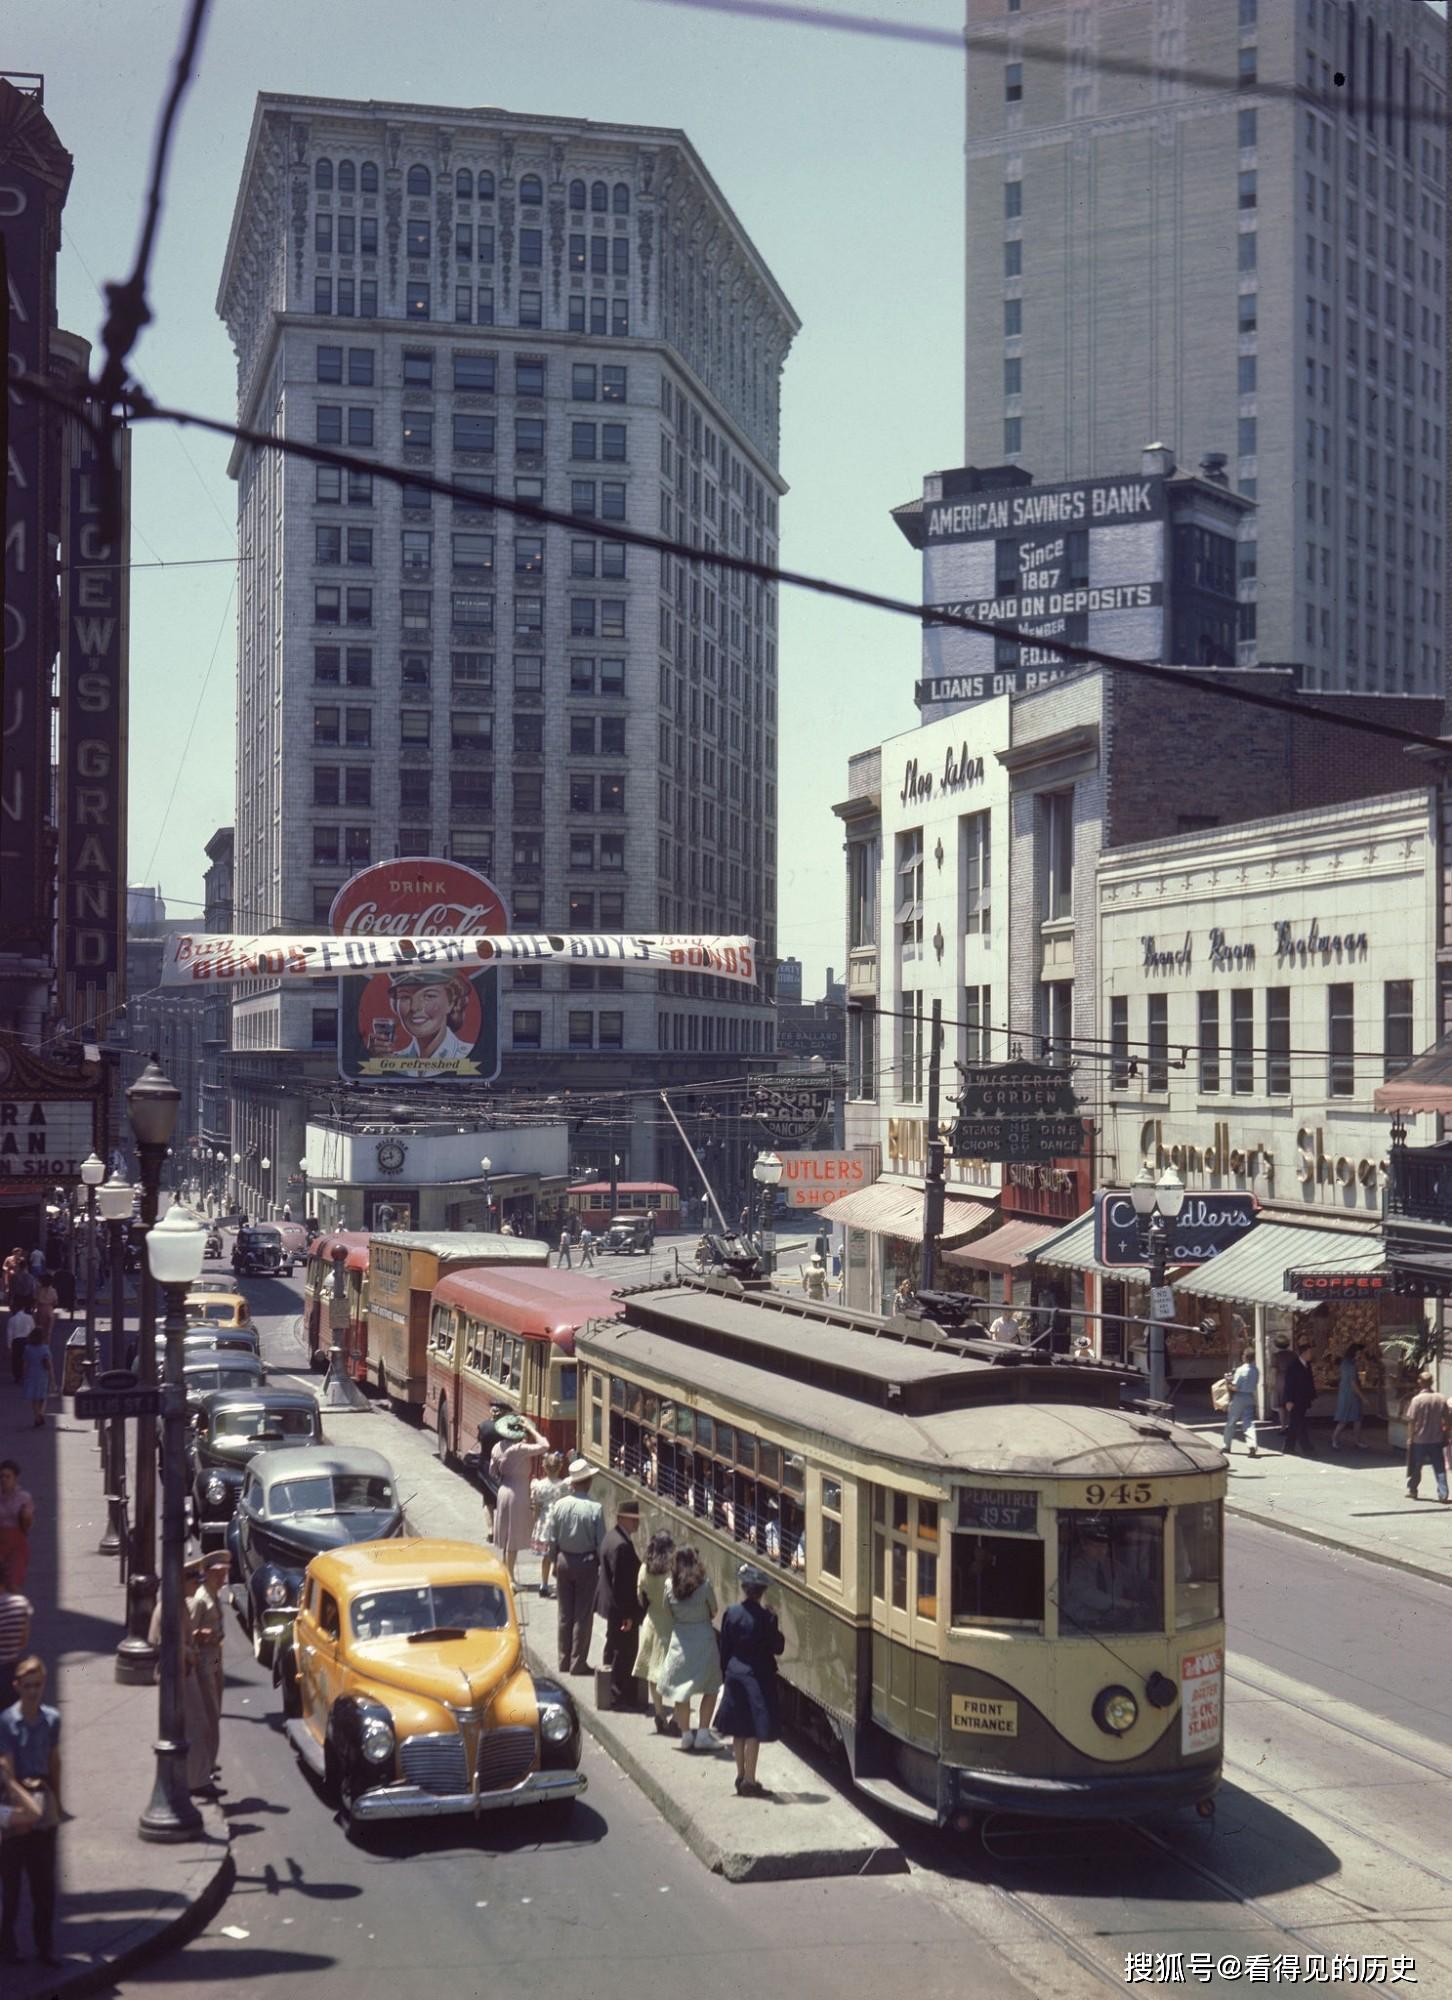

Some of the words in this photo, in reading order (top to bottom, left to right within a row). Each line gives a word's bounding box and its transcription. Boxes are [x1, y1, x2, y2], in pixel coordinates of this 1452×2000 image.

[928, 506, 1009, 536] AMERICAN
[1013, 491, 1085, 526] SAVINGS
[1092, 483, 1151, 516] BANK
[1019, 538, 1064, 571] Since
[1021, 570, 1060, 591] 1887
[978, 599, 1017, 620] PAID
[1022, 597, 1044, 616] ON
[1049, 586, 1151, 613] DEPOSITS
[931, 678, 983, 699] LOANS
[993, 674, 1016, 694] ON
[1026, 671, 1064, 689] REA
[901, 757, 932, 800] Shoe
[940, 741, 984, 789] Salon
[74, 740, 112, 966] GRAND
[390, 880, 446, 894] DRINK
[193, 944, 307, 979] BONDS
[321, 939, 464, 971] FOLLOW
[569, 937, 649, 960] BOYS
[671, 946, 752, 977] BONDS
[380, 1059, 395, 1069] Go
[400, 1059, 460, 1069] refreshed
[976, 1075, 1062, 1088] WISTERIA
[983, 1091, 1056, 1104] GARDEN
[962, 1125, 1000, 1136] STEAKS
[1041, 1125, 1077, 1136] DINE
[962, 1140, 1000, 1151] CHOPS
[1040, 1140, 1078, 1151] DANCE
[24, 1160, 77, 1174] SHOT
[780, 1159, 864, 1180] UTLERS
[1110, 1200, 1251, 1228] Cdler's
[1302, 1278, 1383, 1288] COFFEE
[1086, 1483, 1153, 1507] 945
[1001, 1508, 1020, 1524] ST
[963, 1700, 1003, 1716] FRONT
[954, 1713, 1014, 1734] ENTRANCE
